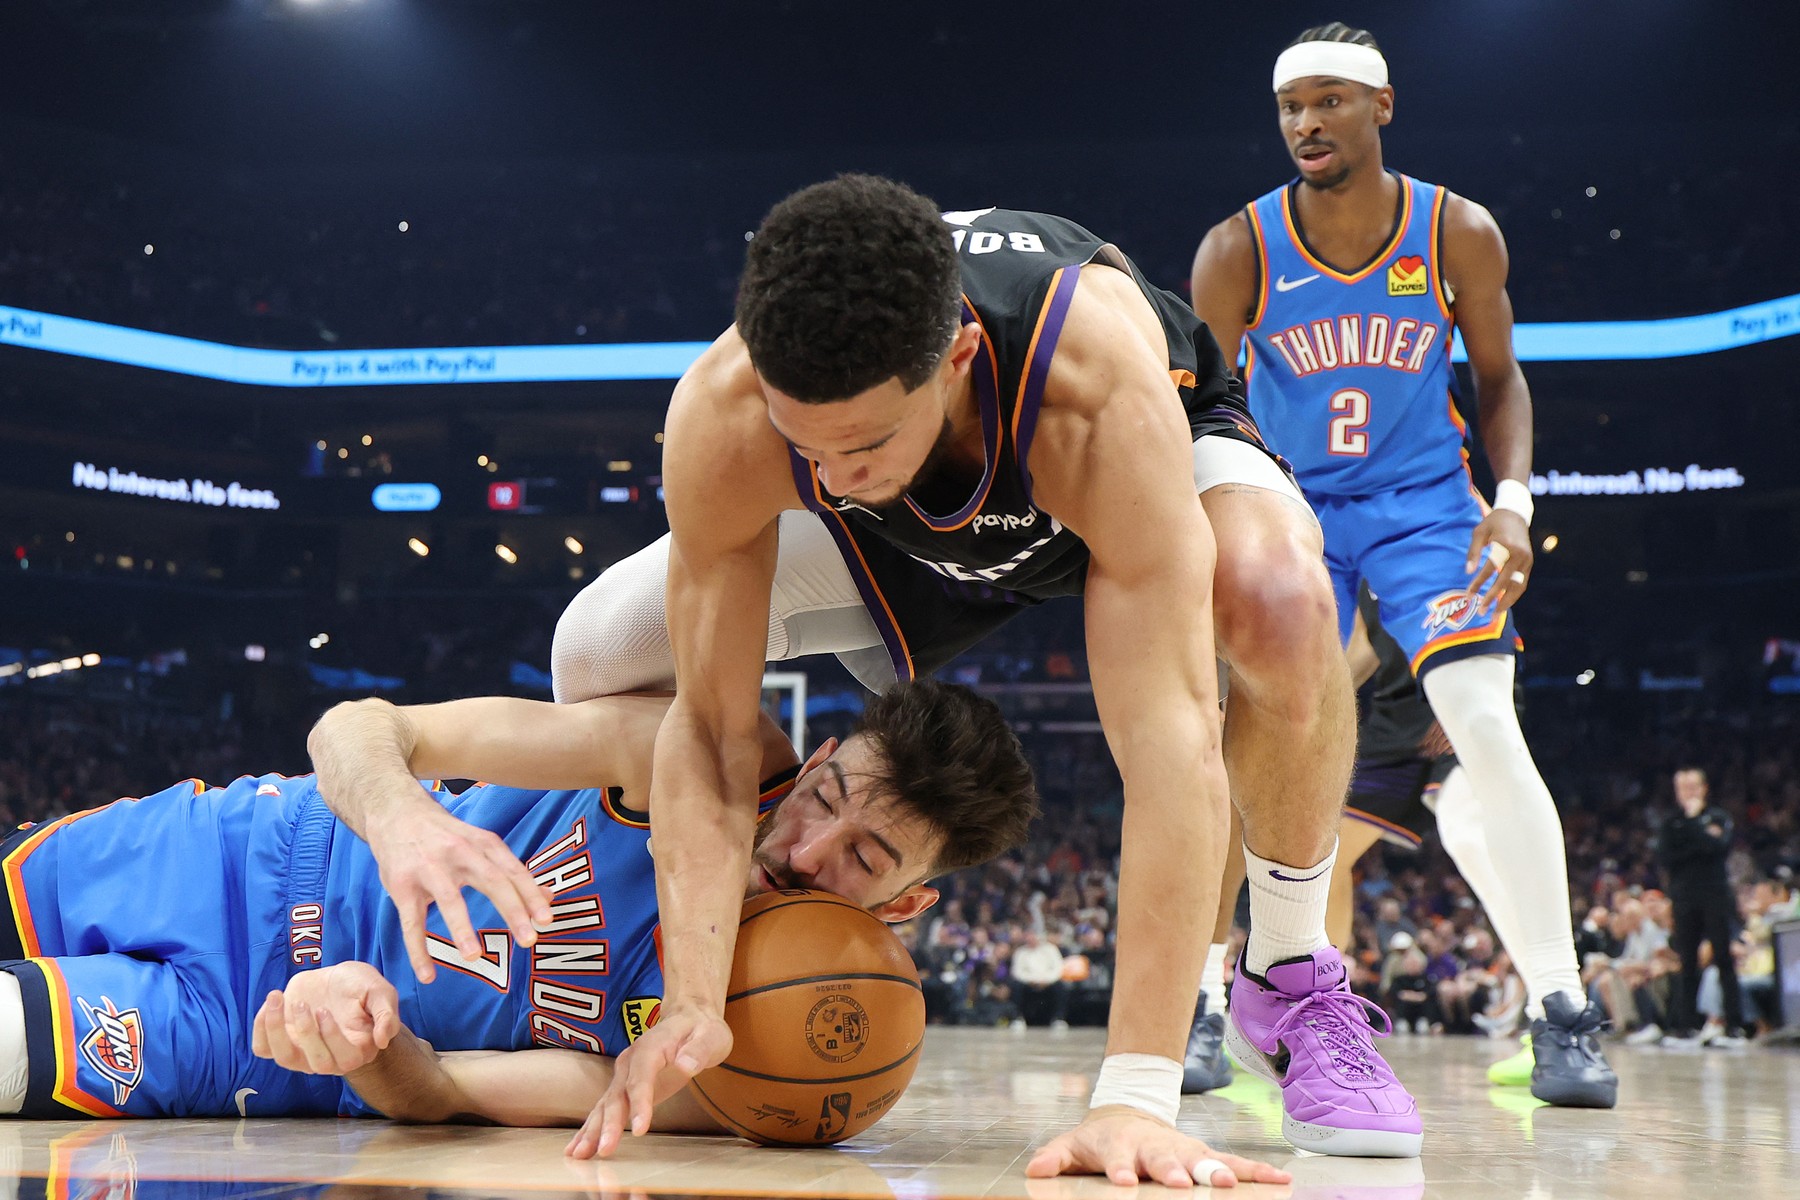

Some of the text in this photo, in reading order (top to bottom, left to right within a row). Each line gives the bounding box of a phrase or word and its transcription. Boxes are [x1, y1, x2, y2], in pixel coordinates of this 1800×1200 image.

[293, 359, 327, 385] Pay
[376, 357, 420, 373] with
[426, 354, 496, 382] PayPal
[1268, 313, 1439, 378] THUNDER
[1327, 387, 1371, 457] 2
[72, 461, 108, 490] No
[191, 478, 227, 507] No
[1644, 467, 1685, 494] No
[289, 903, 323, 966] OKC
[424, 929, 512, 994] 7
[526, 815, 609, 1054] THUNDE
[1317, 960, 1339, 977] BOOK
[93, 1009, 134, 1069] OKC
